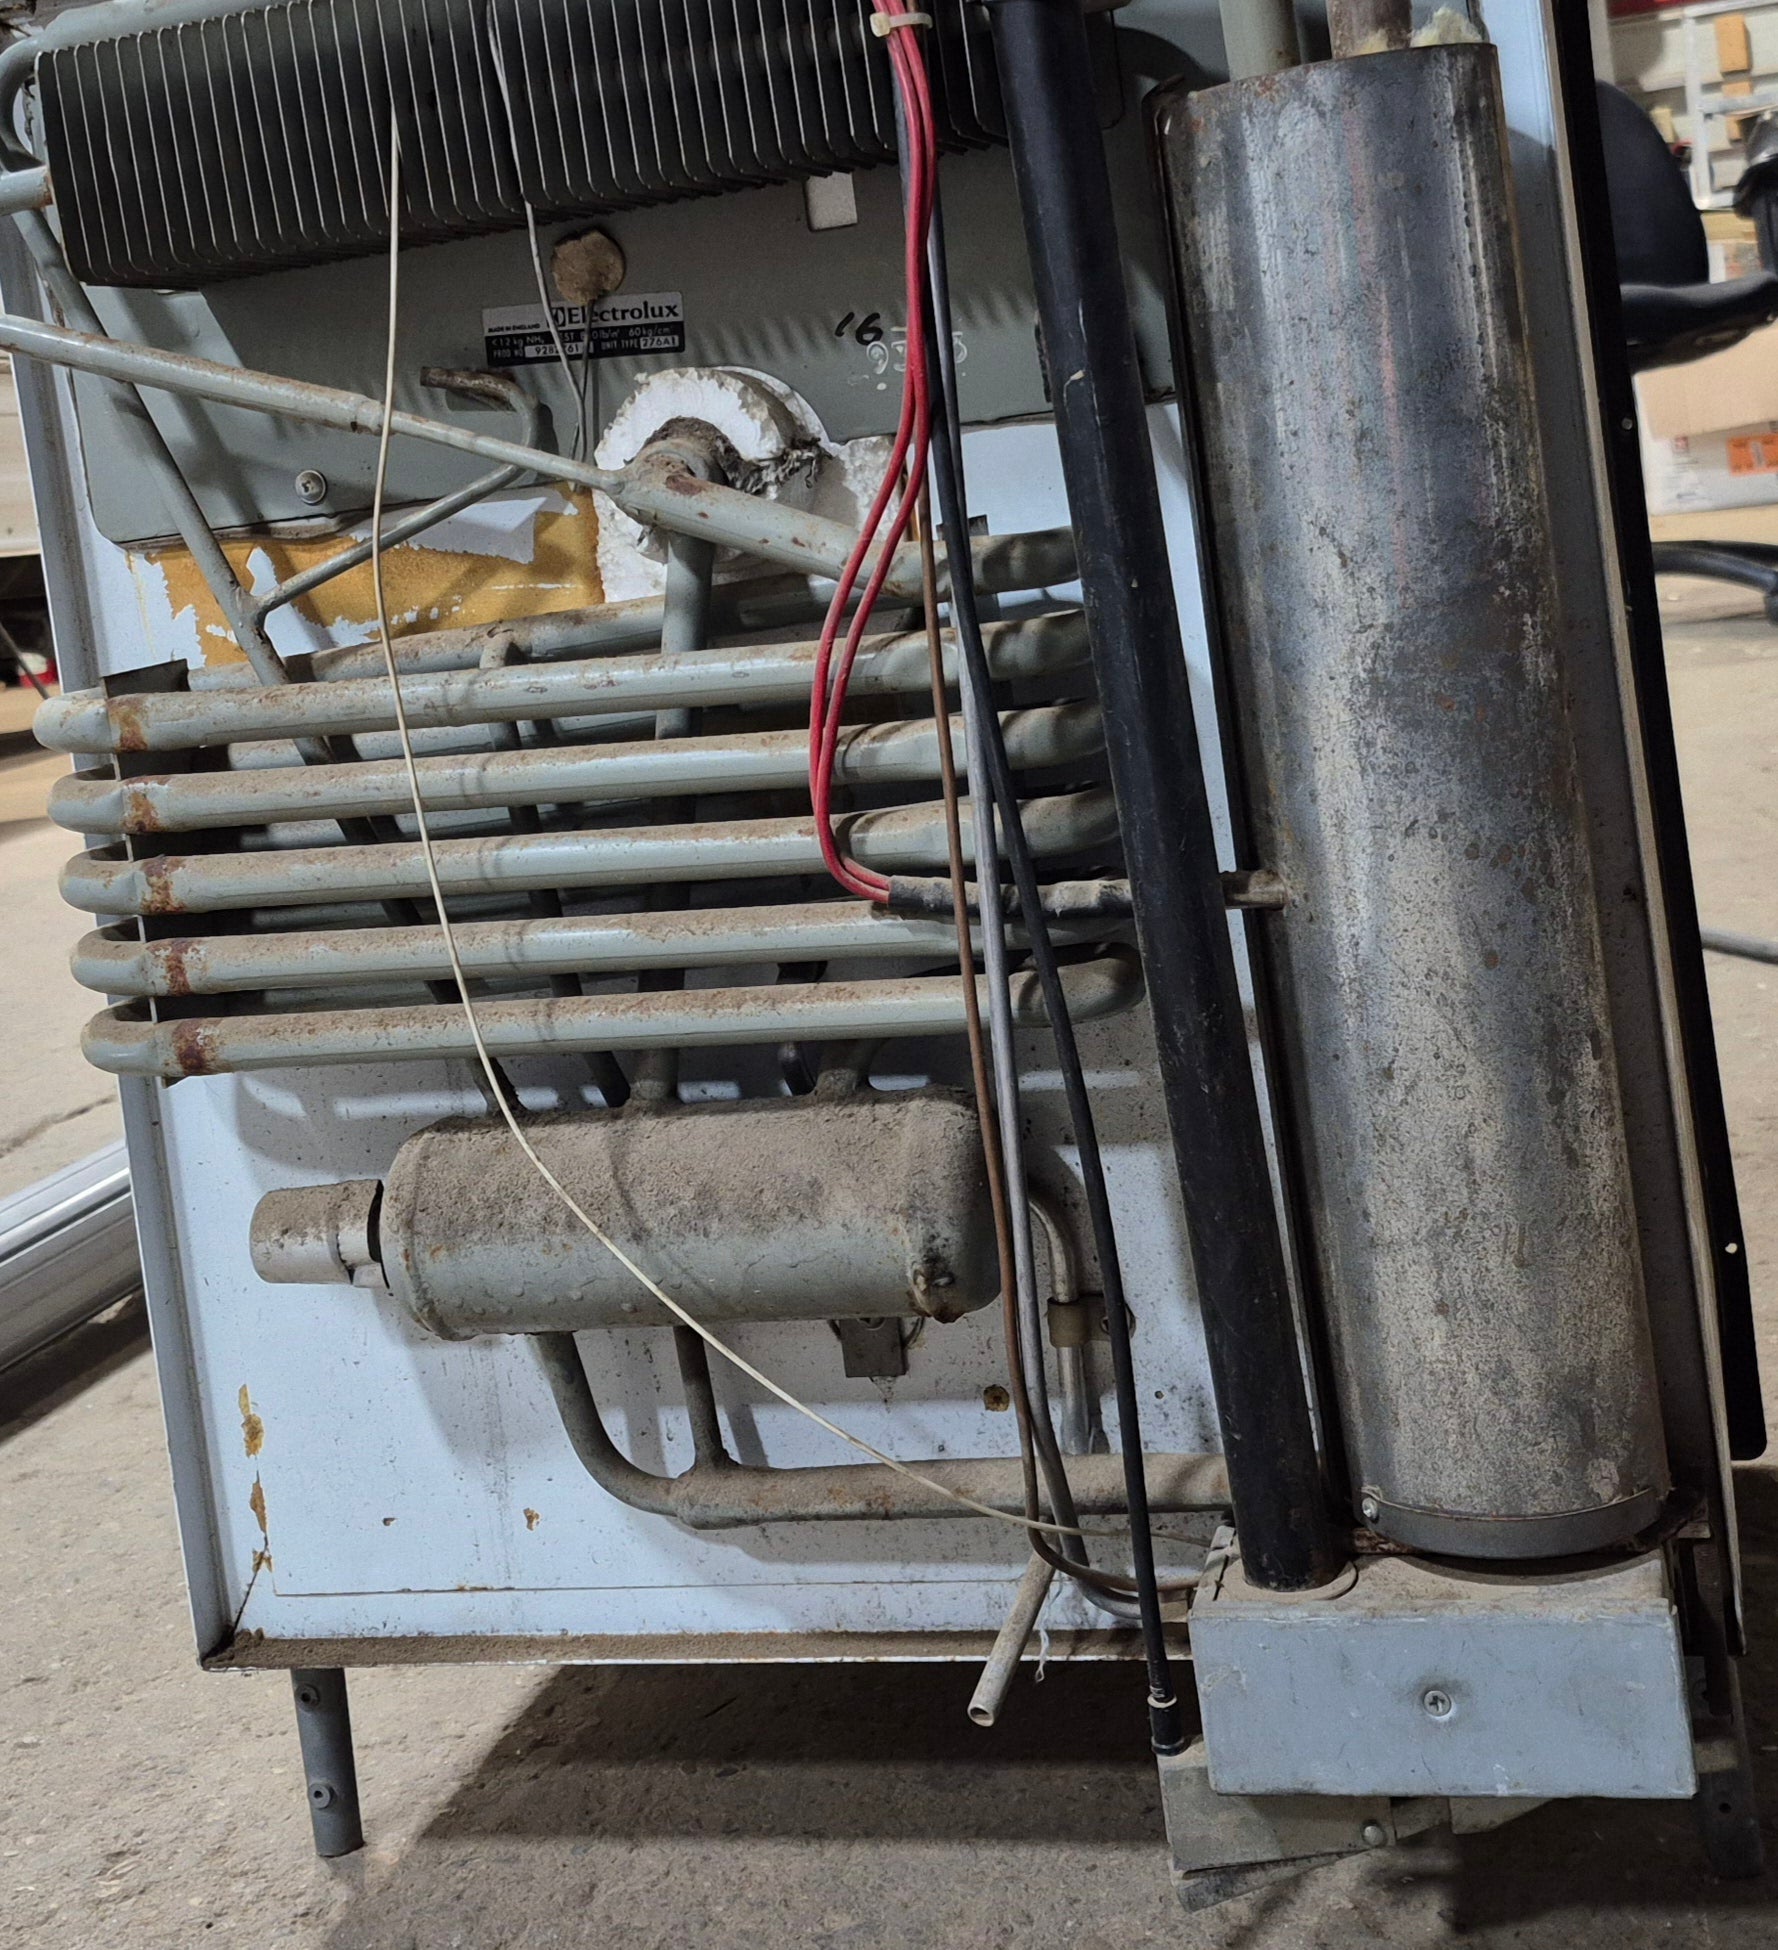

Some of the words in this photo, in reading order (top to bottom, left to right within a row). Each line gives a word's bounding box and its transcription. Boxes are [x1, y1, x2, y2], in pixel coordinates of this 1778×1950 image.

[568, 301, 679, 324] Electrolux
[488, 326, 505, 334] MADE
[512, 323, 541, 331] ENGLAND
